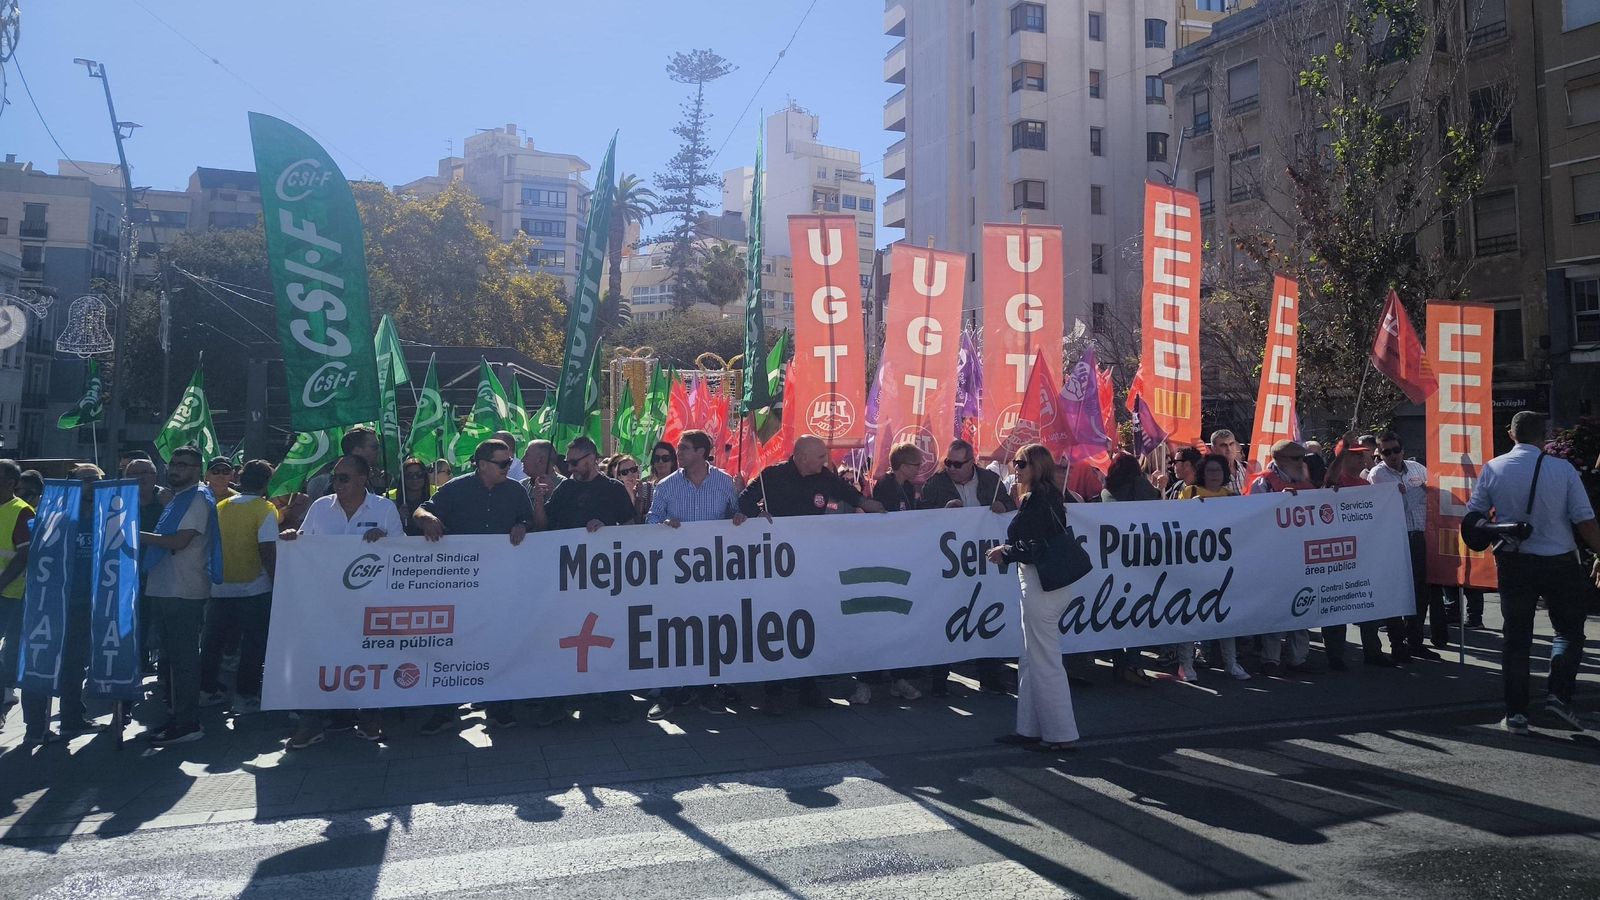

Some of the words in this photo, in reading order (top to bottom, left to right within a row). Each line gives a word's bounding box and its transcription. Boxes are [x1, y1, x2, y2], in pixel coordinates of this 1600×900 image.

[1152, 201, 1192, 381] CCOO
[807, 228, 848, 383] UGT
[1005, 235, 1043, 392] UGT
[904, 257, 947, 415] UGT
[813, 400, 847, 418] UGT
[1340, 501, 1374, 511] Servicios
[1276, 505, 1316, 528] UGT
[1341, 512, 1374, 523] Públicos
[393, 553, 434, 563] Central
[436, 553, 480, 563] Sindical
[940, 531, 1087, 579] Servs
[1100, 521, 1232, 569] Públicos
[1308, 541, 1354, 560] CCOO
[351, 564, 385, 578] CSIF
[392, 566, 470, 579] Independiente
[472, 567, 480, 577] y
[559, 541, 663, 596] Mejor
[673, 532, 796, 584] salario
[1305, 565, 1325, 575] área
[1327, 561, 1356, 575] pública
[391, 580, 405, 590] de
[408, 579, 480, 590] Funcionarios
[1320, 583, 1344, 593] Central
[1345, 579, 1370, 589] Sindical
[945, 581, 1006, 643] de
[1057, 566, 1234, 635] alidad
[1296, 595, 1317, 608] CSIF
[1320, 592, 1366, 604] Independiente
[29, 556, 54, 669] SIAT
[101, 558, 120, 677] SIAT
[1320, 606, 1329, 615] de
[1329, 602, 1375, 613] Funcionarios
[370, 610, 449, 630] CCOO
[361, 636, 395, 649] área
[399, 635, 454, 650] pública
[628, 598, 816, 677] Empleo
[433, 660, 490, 672] Servicios
[318, 664, 388, 692] UGT
[432, 675, 484, 688] Públicos
